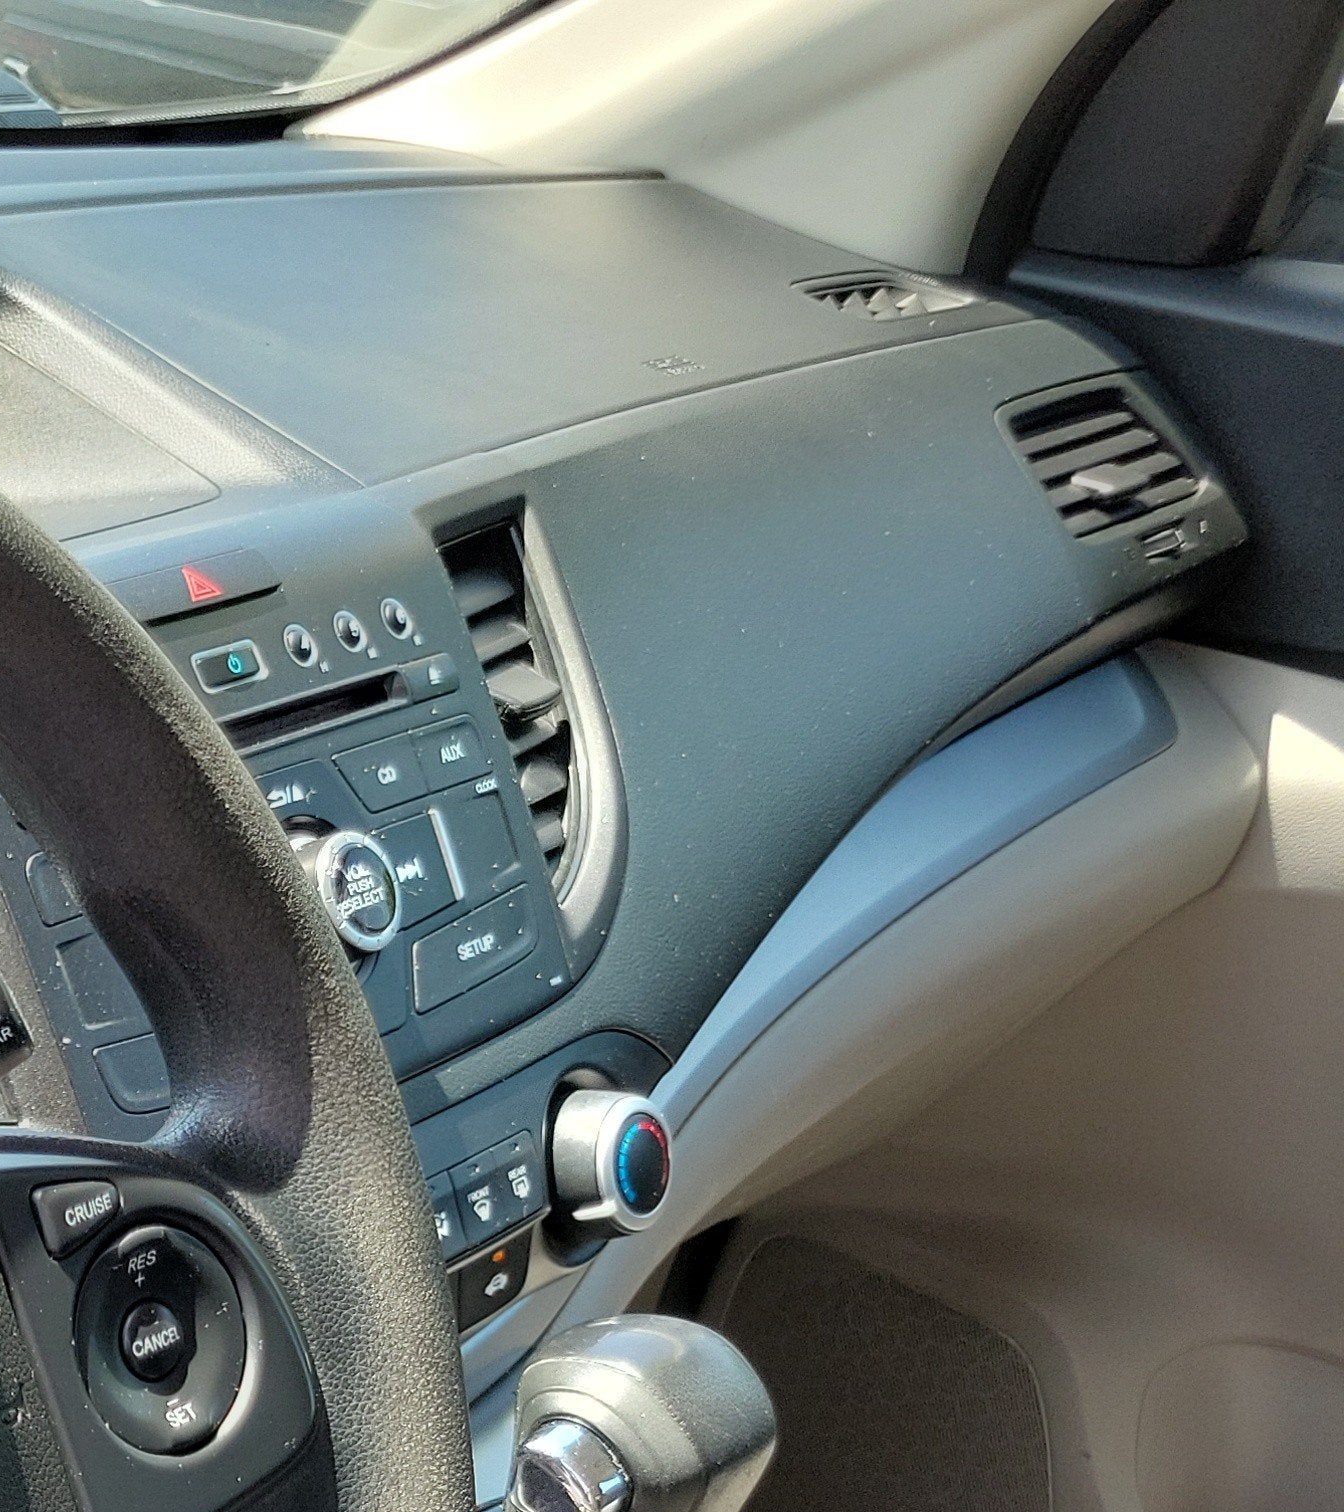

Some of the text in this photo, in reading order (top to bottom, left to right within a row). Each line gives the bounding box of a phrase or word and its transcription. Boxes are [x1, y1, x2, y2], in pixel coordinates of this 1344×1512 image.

[440, 742, 465, 765] AUX
[377, 766, 397, 785] CD
[346, 878, 375, 897] PUSH
[457, 934, 494, 961] SETUP
[64, 1194, 113, 1227] CRUISE
[127, 1250, 157, 1275] RES
[131, 1327, 181, 1357] CANCEL
[165, 1403, 197, 1428] SET
